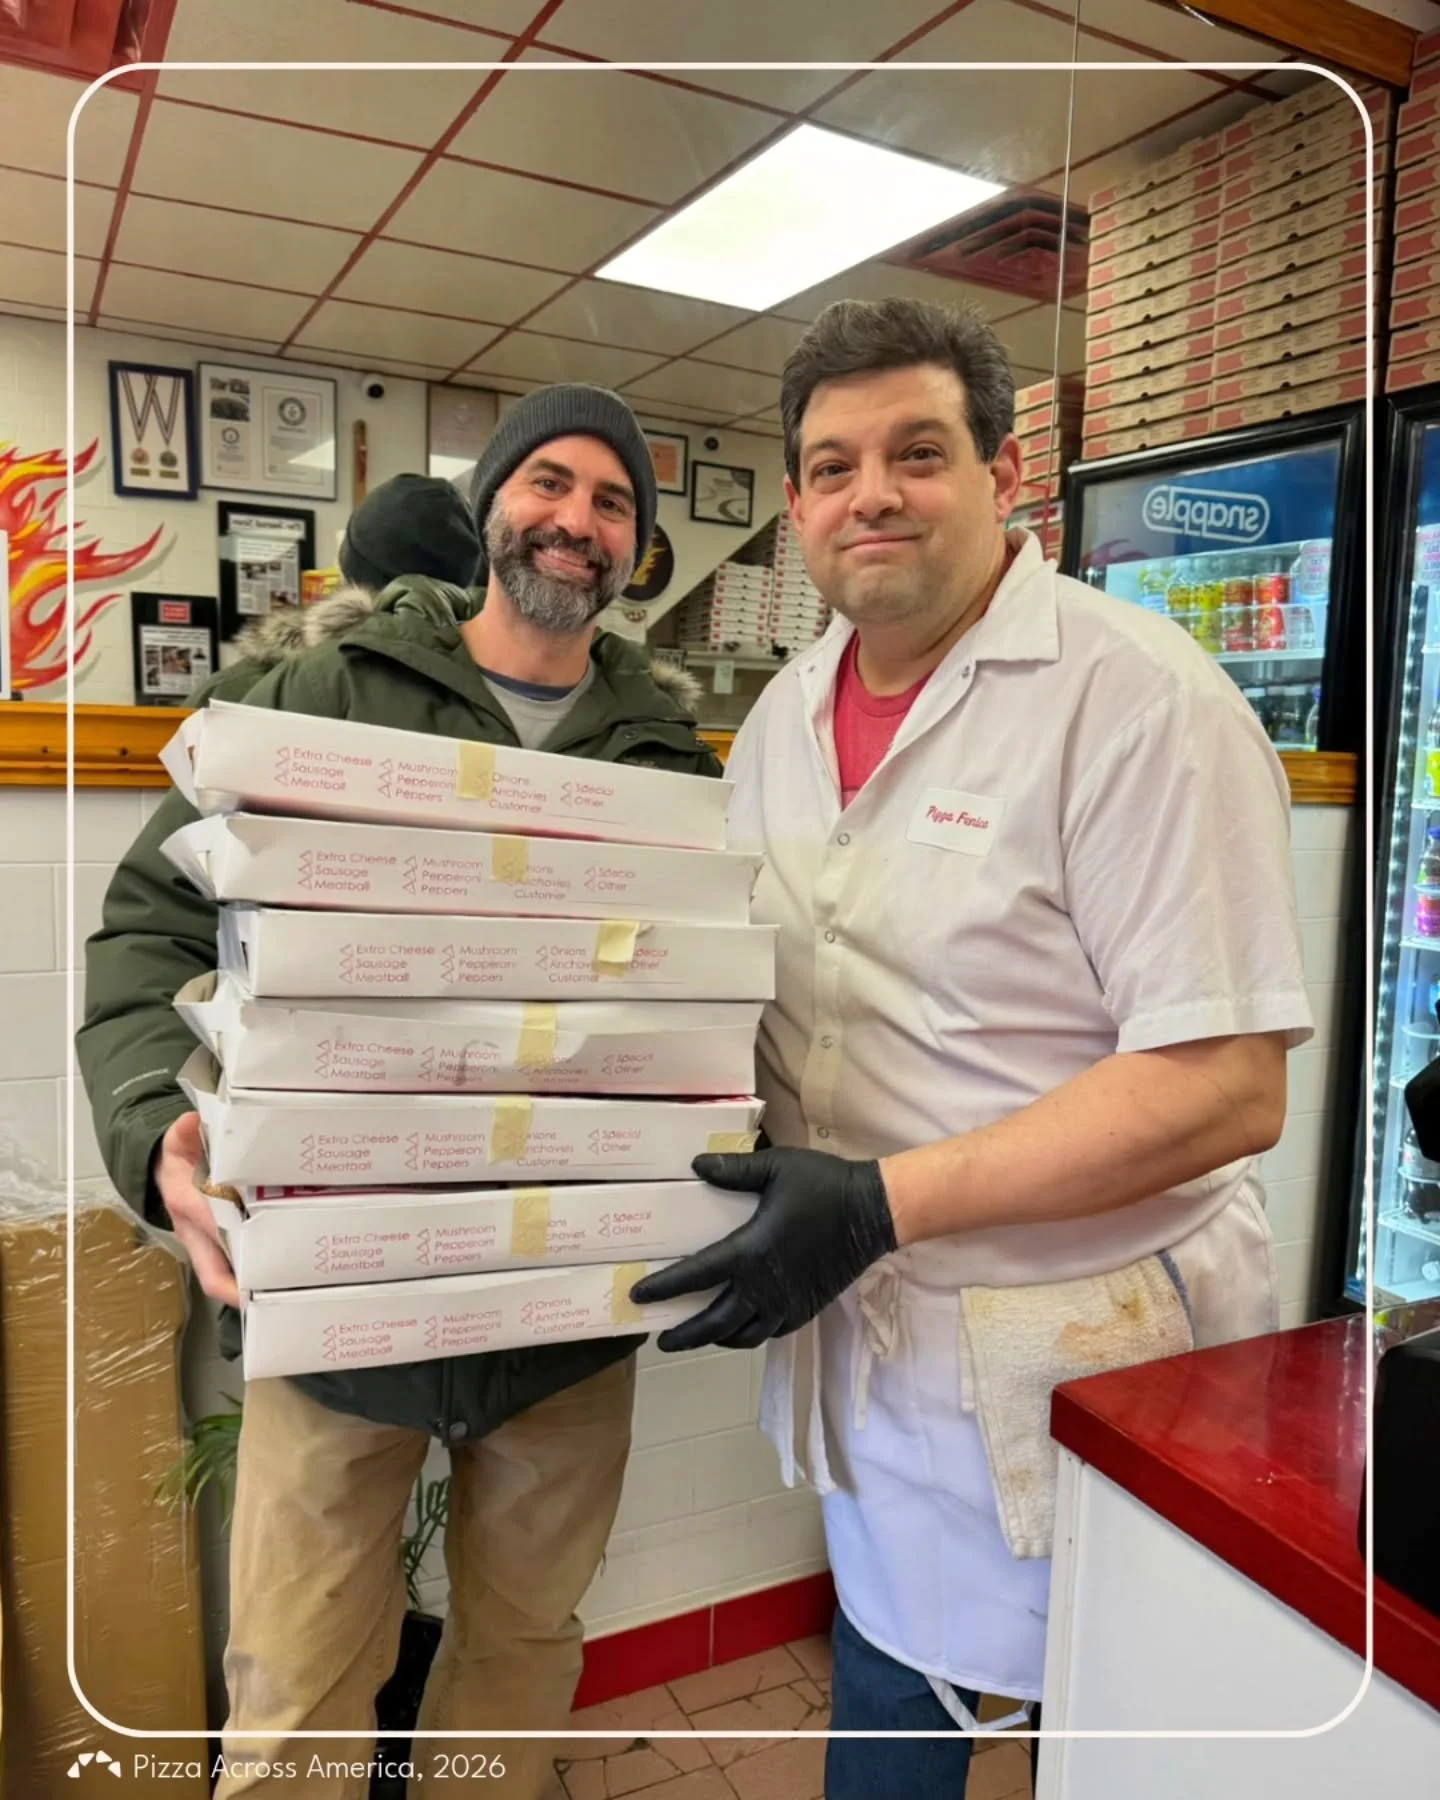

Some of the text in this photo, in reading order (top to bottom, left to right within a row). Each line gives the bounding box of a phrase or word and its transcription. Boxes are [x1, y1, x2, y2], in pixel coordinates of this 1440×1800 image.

[294, 748, 372, 767] Extra Cheese
[292, 762, 344, 778] Sausage
[399, 762, 458, 777] Mushroom
[291, 777, 346, 790] Meatball
[395, 788, 443, 802] Peppers
[489, 800, 542, 814] Customer
[574, 796, 604, 808] Other
[316, 852, 396, 864] Extra Cheese
[422, 857, 482, 868] Mushroom
[314, 865, 369, 878] Sausage
[422, 870, 482, 884] Pepperoni
[314, 880, 370, 892] Meatball
[420, 884, 468, 897] Peppers
[597, 881, 628, 892] Other
[514, 888, 566, 901] Customer
[356, 945, 435, 956] Extra Cheese
[460, 946, 517, 956] Mushroom
[550, 946, 586, 956] Onions
[356, 958, 408, 970] Sausage
[459, 959, 516, 970] Pepperoni
[630, 960, 659, 970] Other
[356, 973, 410, 983] Meatball
[458, 972, 502, 984] Peppers
[549, 973, 599, 984] Customer
[334, 1041, 414, 1056] Extra Cheese
[332, 1054, 386, 1068] Sausage
[331, 1069, 386, 1080] Meatball
[318, 1134, 399, 1146] Extra Cheese
[425, 1132, 486, 1143] Mushroom
[601, 1129, 642, 1140] Special
[317, 1148, 370, 1159] Sausage
[424, 1146, 483, 1158] Pepperoni
[600, 1142, 632, 1153] Other
[317, 1162, 372, 1172] Meatball
[422, 1159, 470, 1170] Peppers
[516, 1157, 570, 1168] Customer
[612, 1211, 652, 1223] Special
[436, 1224, 496, 1238] Mushroom
[612, 1225, 642, 1235] Other
[332, 1230, 410, 1246] Extra Cheese
[435, 1238, 496, 1252] Pepperoni
[331, 1247, 383, 1260] Sausage
[434, 1253, 482, 1266] Peppers
[331, 1259, 385, 1272] Meatball
[535, 1297, 572, 1310] Onions
[443, 1310, 502, 1322] Mushroom
[535, 1308, 590, 1323] Anchovies
[339, 1318, 417, 1334] Extra Cheese
[534, 1321, 585, 1335] Customer
[339, 1334, 391, 1347] Sausage
[339, 1346, 393, 1359] Meatball
